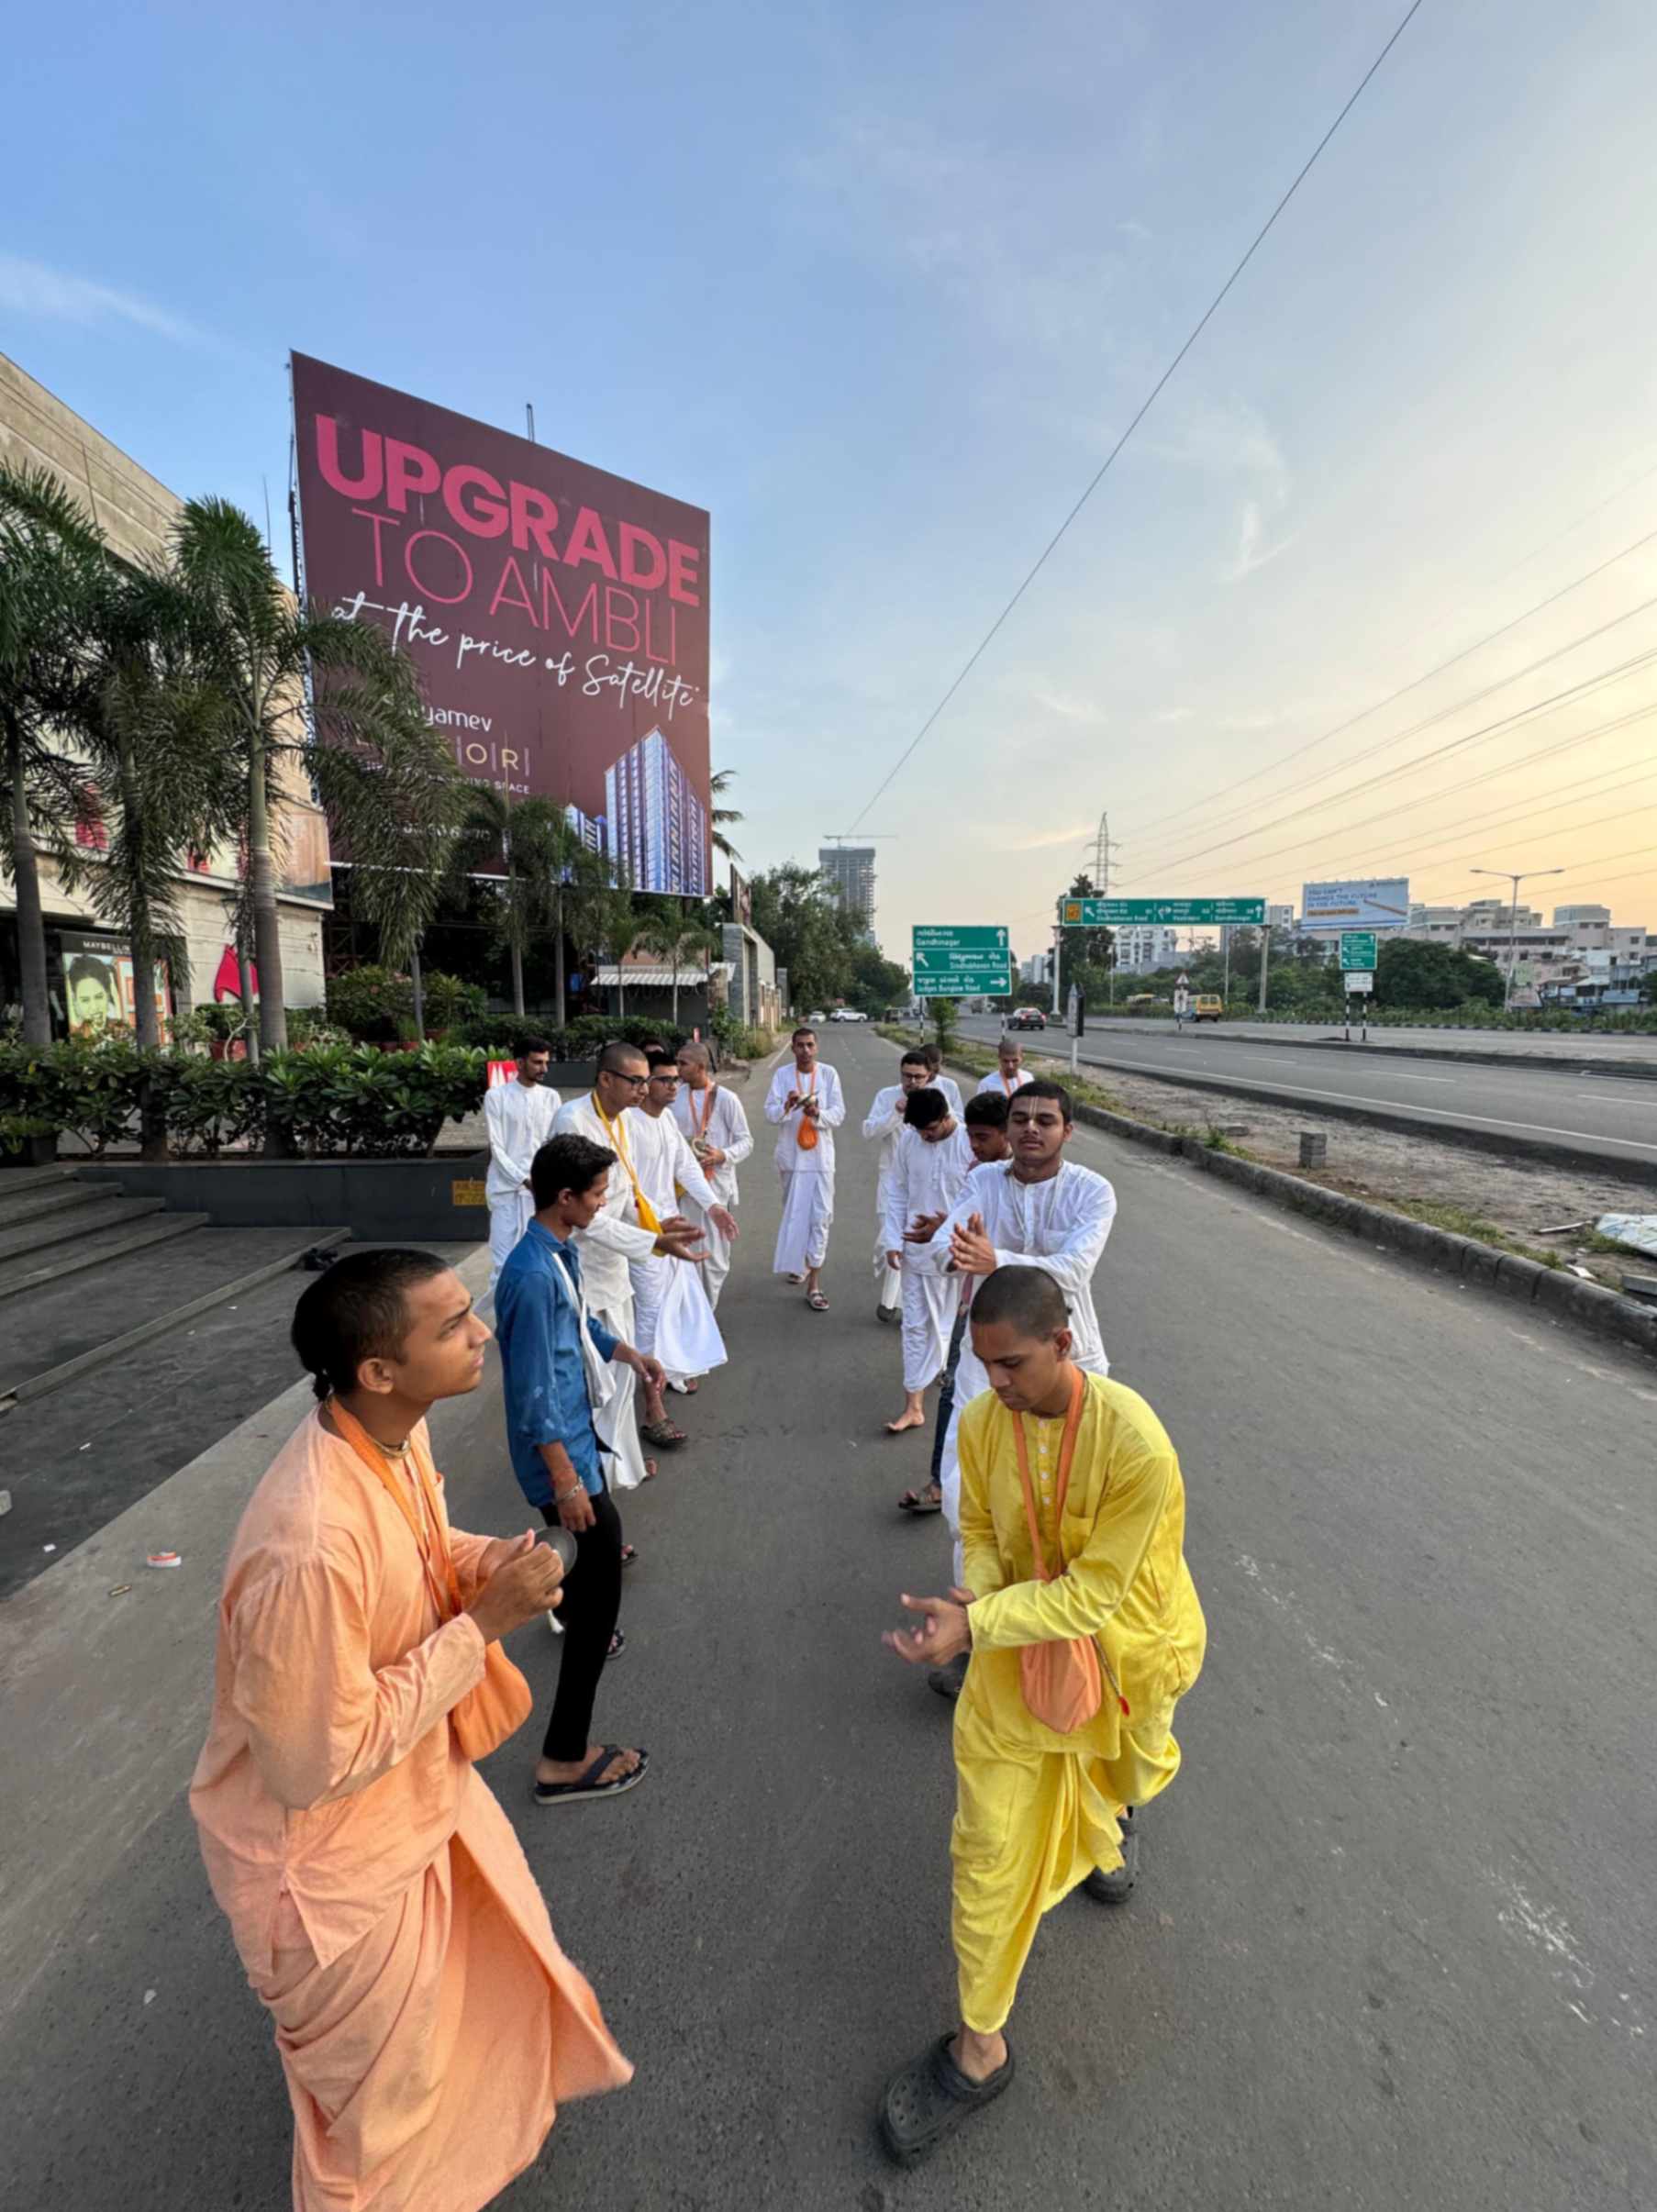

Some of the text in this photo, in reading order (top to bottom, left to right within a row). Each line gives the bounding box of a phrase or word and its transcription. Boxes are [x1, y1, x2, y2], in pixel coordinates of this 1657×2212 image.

[315, 414, 700, 607] UPGRADE
[331, 591, 695, 721] at the price of Satellite
[352, 507, 676, 666] TO AMBLI
[83, 940, 131, 951] MAYBELLIN
